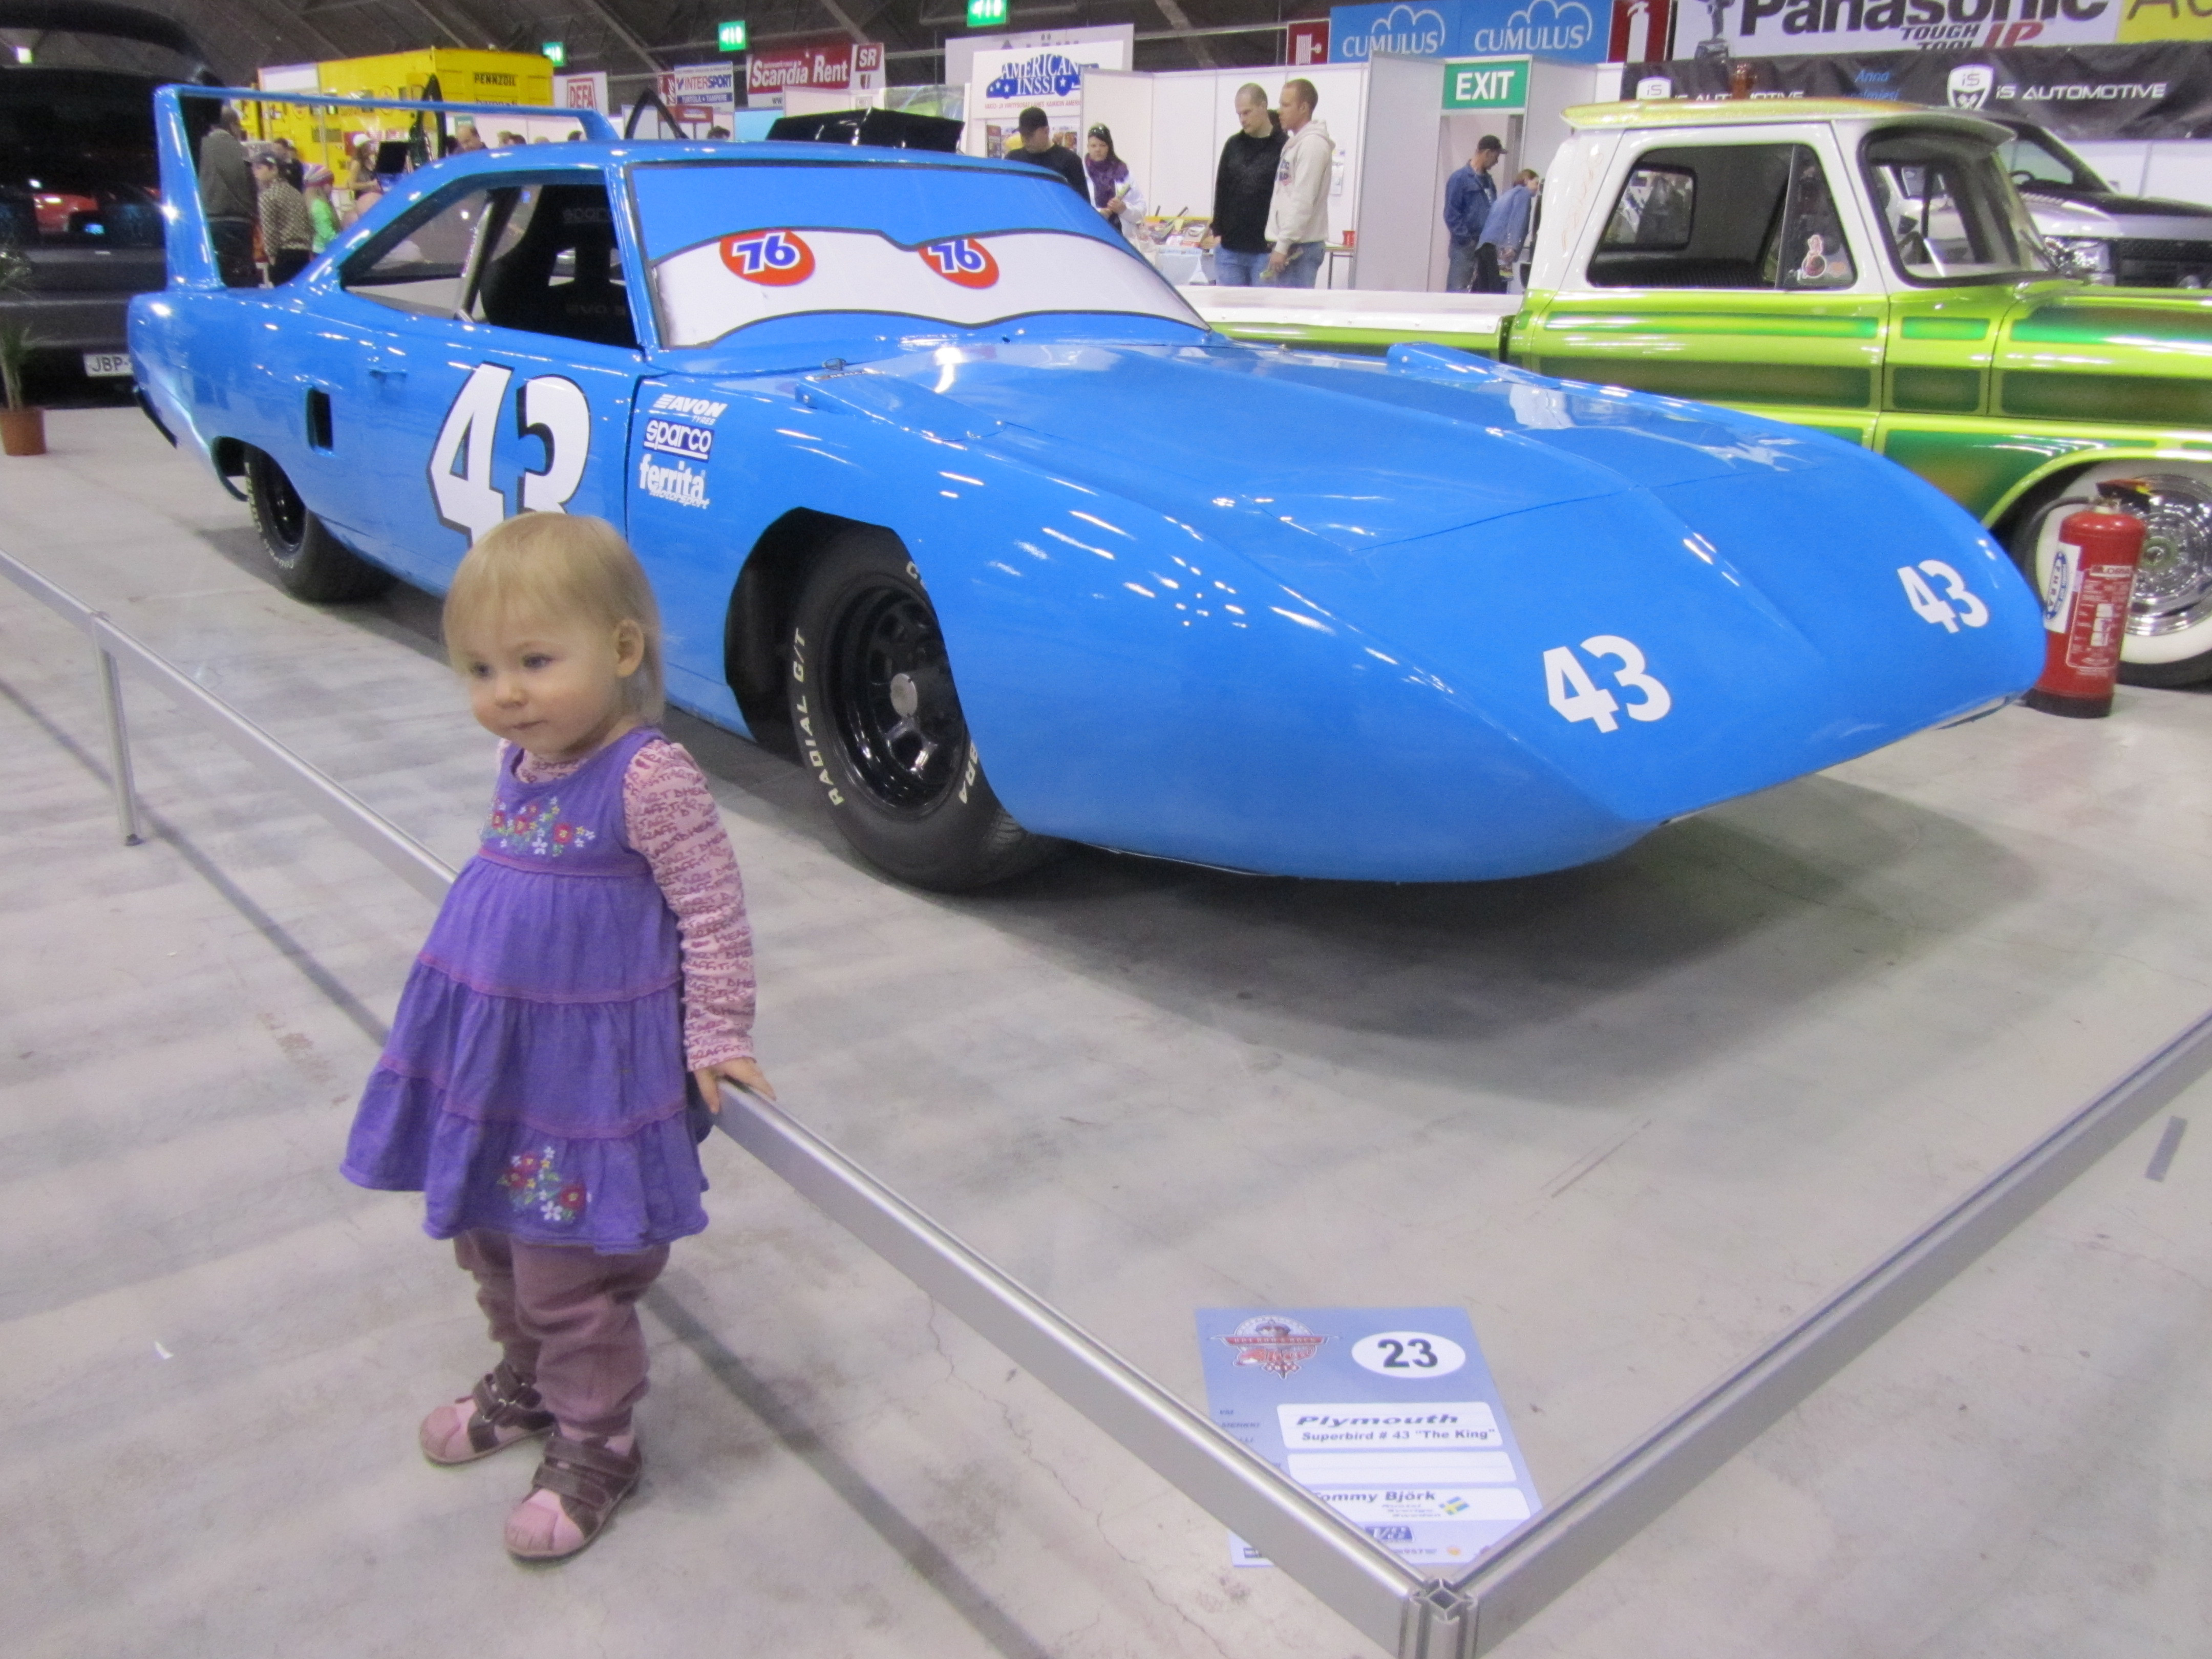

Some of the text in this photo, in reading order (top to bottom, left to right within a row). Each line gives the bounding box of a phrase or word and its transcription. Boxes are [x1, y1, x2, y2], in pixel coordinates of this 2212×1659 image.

[1740, 0, 2109, 36] Panasonic
[1342, 31, 1439, 57] CUMULUS
[1474, 25, 1586, 51] CUMULUS
[1900, 24, 1981, 40] TOUGH
[859, 49, 877, 67] SR
[1000, 54, 1079, 80] AMERICAN
[685, 74, 732, 90] INTERSPORT
[752, 55, 848, 88] Scandia Rent
[569, 85, 594, 110] DEFA
[1016, 76, 1056, 95] INSSI
[1455, 71, 1515, 100] EXIT
[1695, 90, 1804, 101] AUTOTIVE
[1996, 83, 2167, 100] iS AUTOMOTIVE
[732, 232, 800, 274] 76
[928, 239, 986, 273] 76
[668, 396, 728, 418] AVON
[692, 415, 716, 426] TYRES
[646, 420, 712, 453] sparco
[427, 360, 590, 548] 43
[640, 453, 705, 501] ferrita
[649, 485, 710, 509] Motorsport
[1897, 560, 1989, 633] 43
[1543, 635, 1671, 733] 43
[793, 627, 844, 806] RADIAL G/T
[959, 739, 978, 804] BRA
[1377, 1338, 1438, 1368] 23
[1296, 1414, 1459, 1428] Plymouth
[1302, 1429, 1496, 1441] Superbird # 43 "The King"
[1385, 1491, 1436, 1502] Björk
